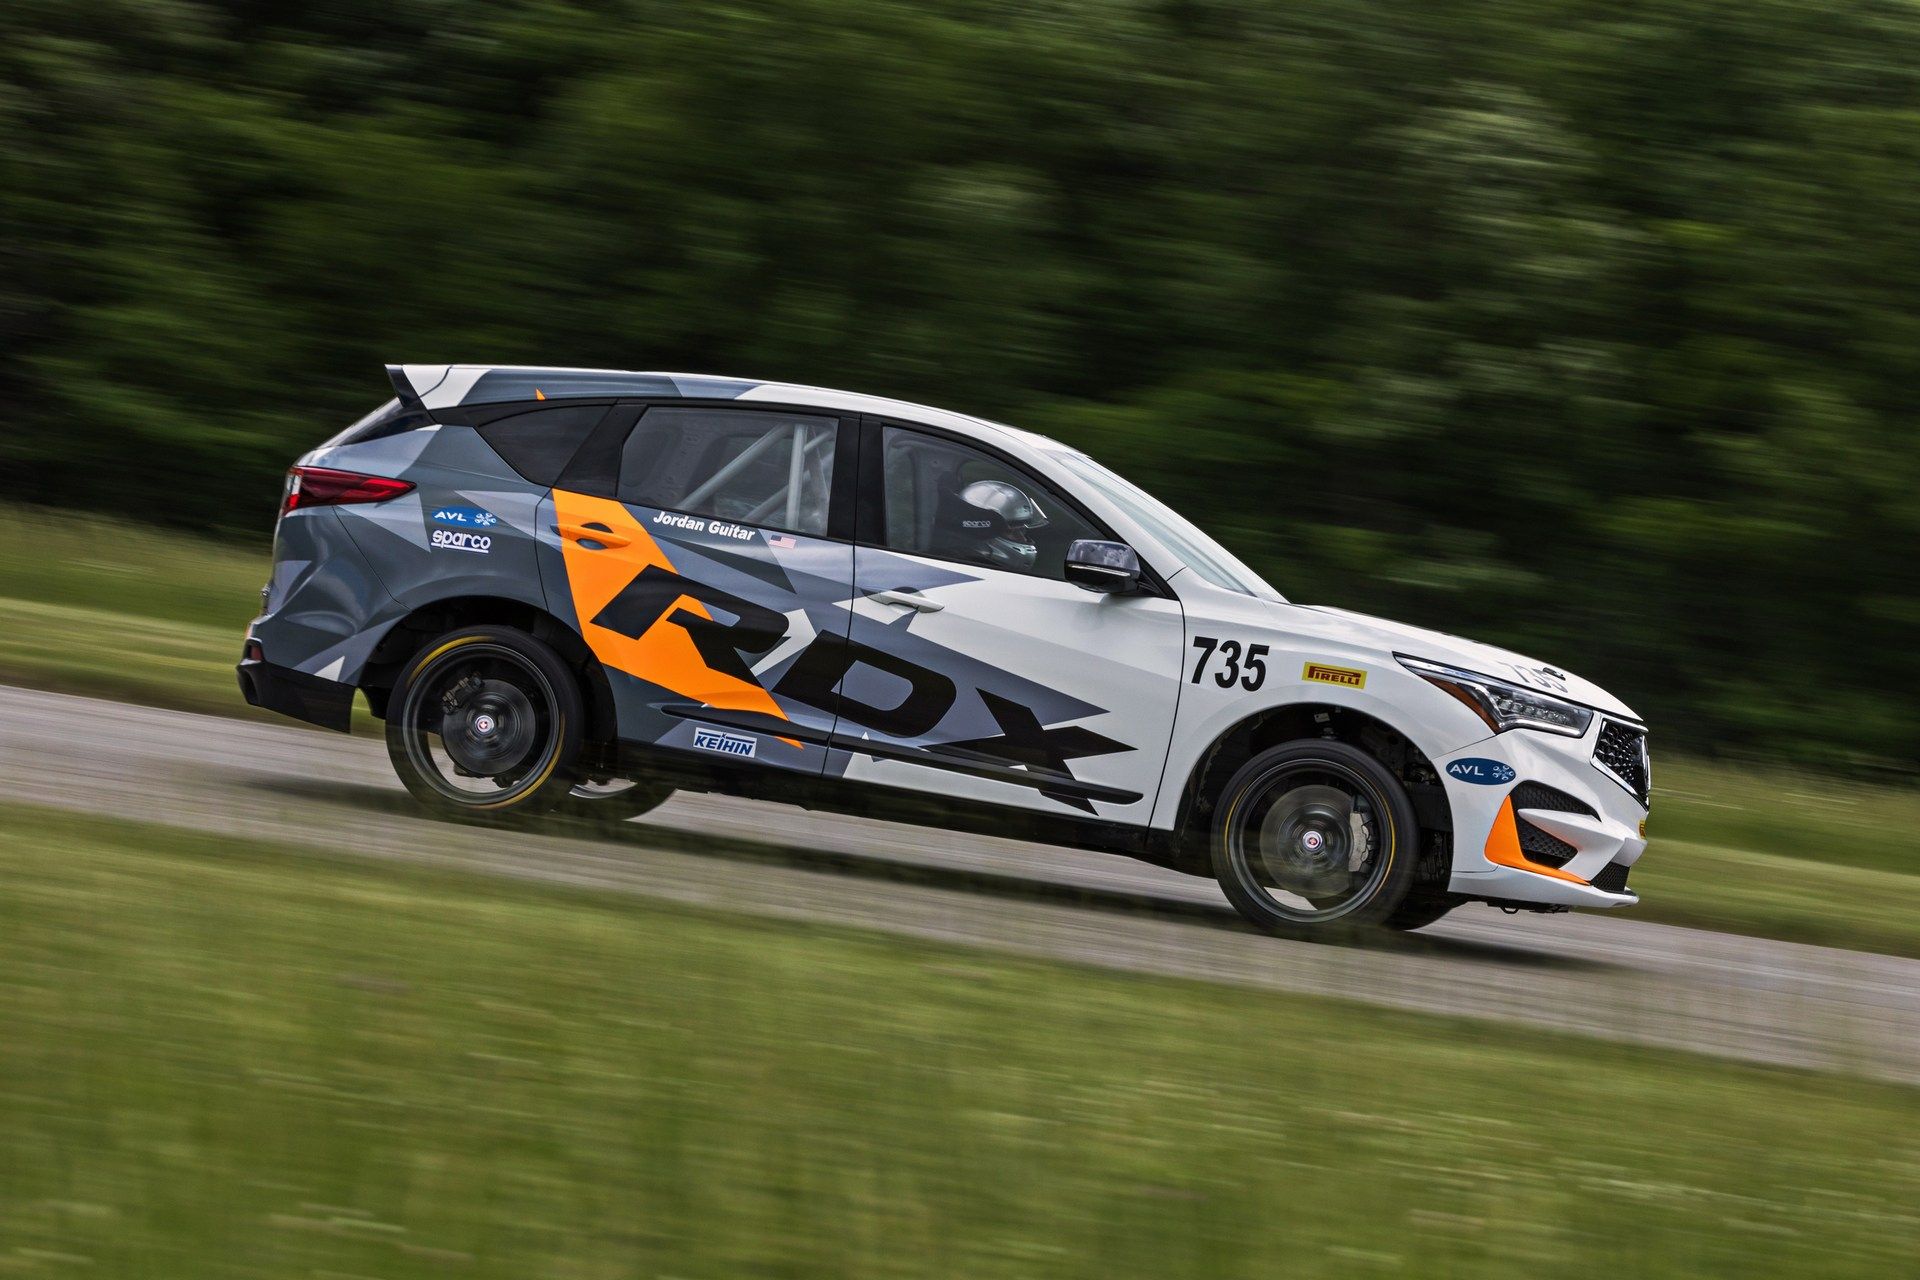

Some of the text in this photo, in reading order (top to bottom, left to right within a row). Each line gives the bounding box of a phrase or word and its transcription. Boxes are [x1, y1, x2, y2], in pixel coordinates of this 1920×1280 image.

[434, 511, 467, 522] AVL
[653, 511, 755, 541] Jordan Guitar
[431, 529, 491, 553] sparco
[1191, 636, 1270, 692] 735
[1307, 665, 1362, 686] PIRELLI
[590, 564, 1140, 816] RDX
[694, 733, 753, 756] KEIHIN
[1449, 764, 1485, 776] AVL
